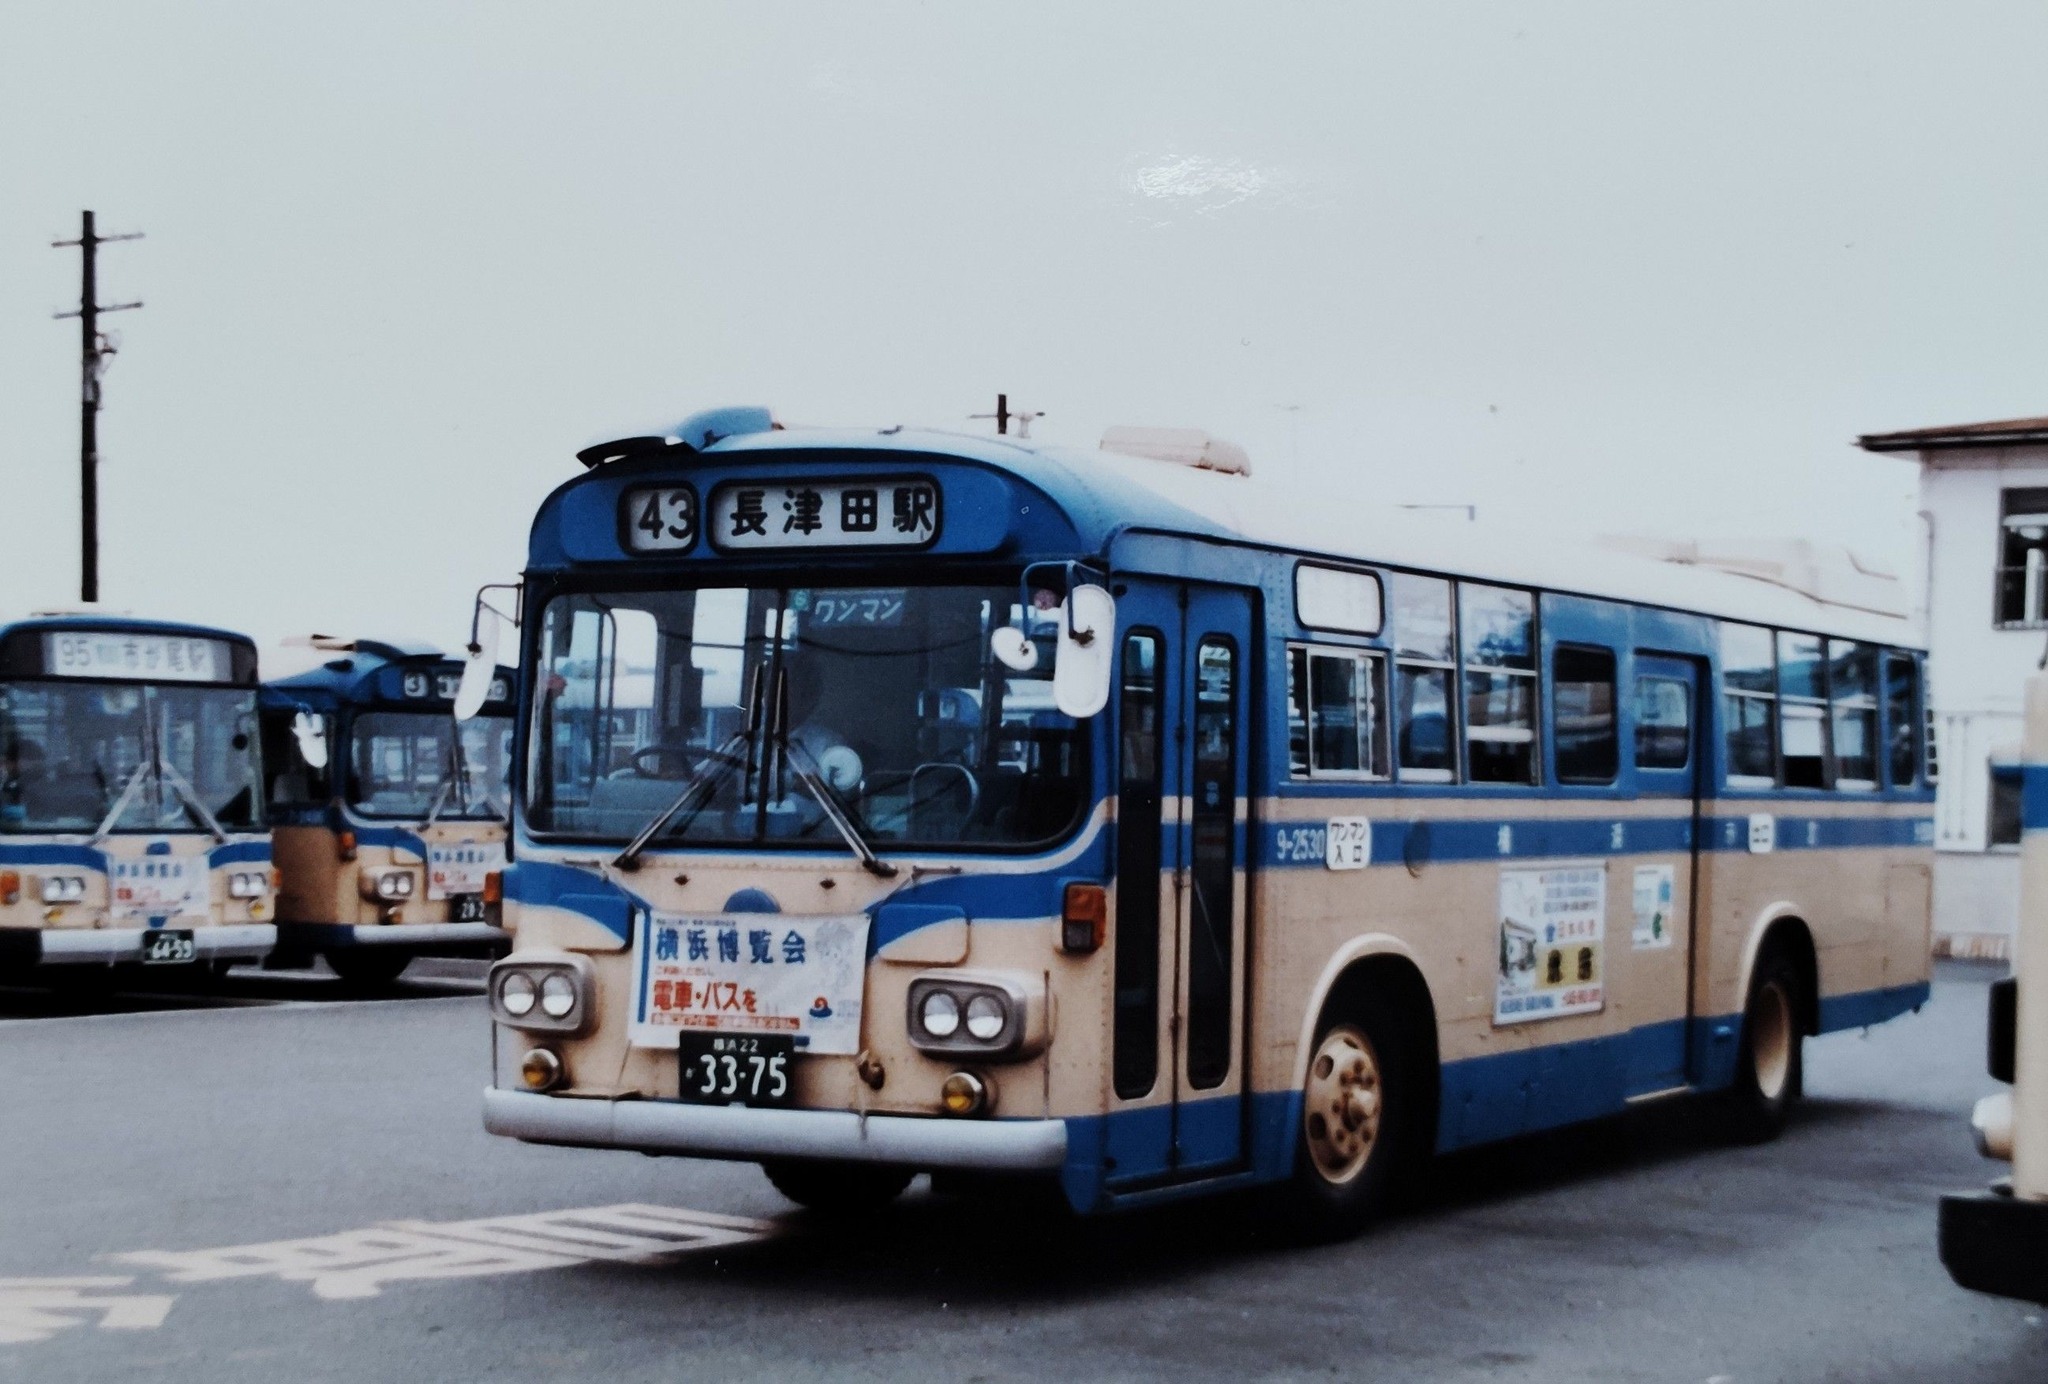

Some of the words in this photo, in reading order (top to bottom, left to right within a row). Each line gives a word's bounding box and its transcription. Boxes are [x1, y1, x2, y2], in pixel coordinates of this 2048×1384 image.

[638, 491, 694, 539] 43
[729, 486, 934, 537] 長津田駅
[814, 597, 903, 623] ワンマン
[61, 638, 91, 667] 95
[1276, 828, 1326, 861] 9-2530
[656, 926, 806, 964] 横浜博覧会
[653, 979, 757, 1014] 電車・バスを
